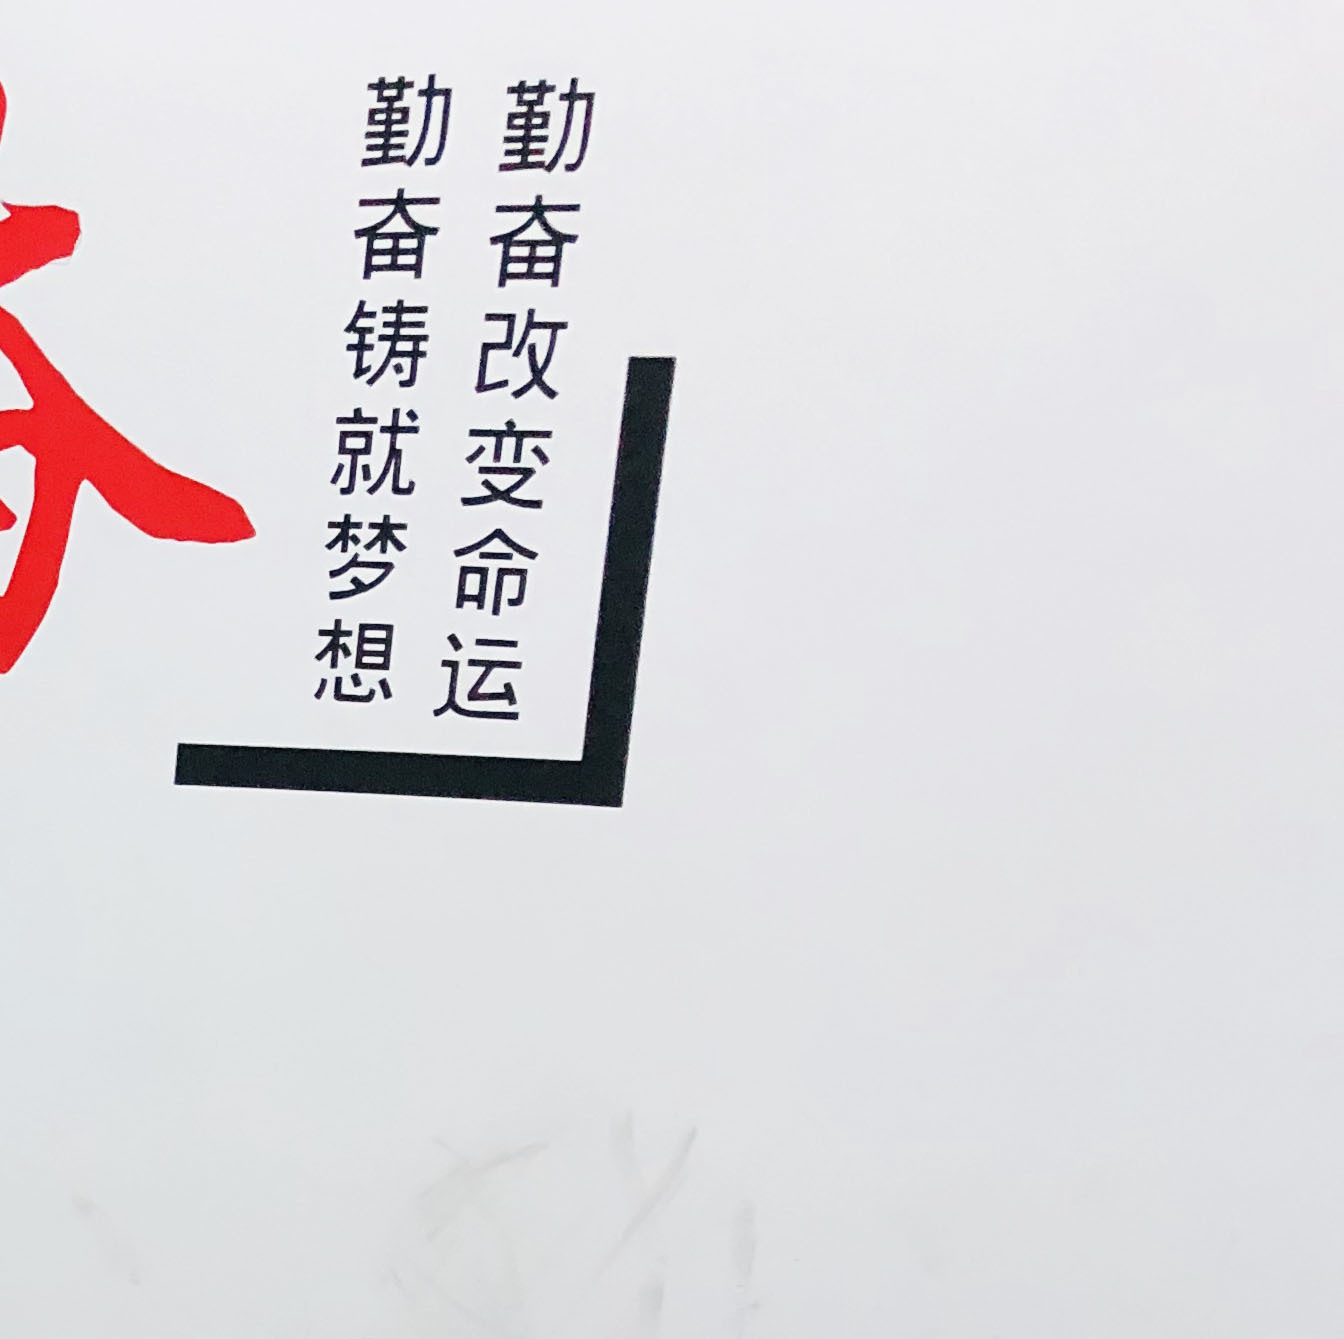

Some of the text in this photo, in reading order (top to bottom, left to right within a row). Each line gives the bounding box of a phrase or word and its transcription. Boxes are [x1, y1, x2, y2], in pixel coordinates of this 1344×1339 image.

[313, 74, 452, 703] 勤奋铸就梦想
[433, 77, 595, 721] 勤奋改变命运
